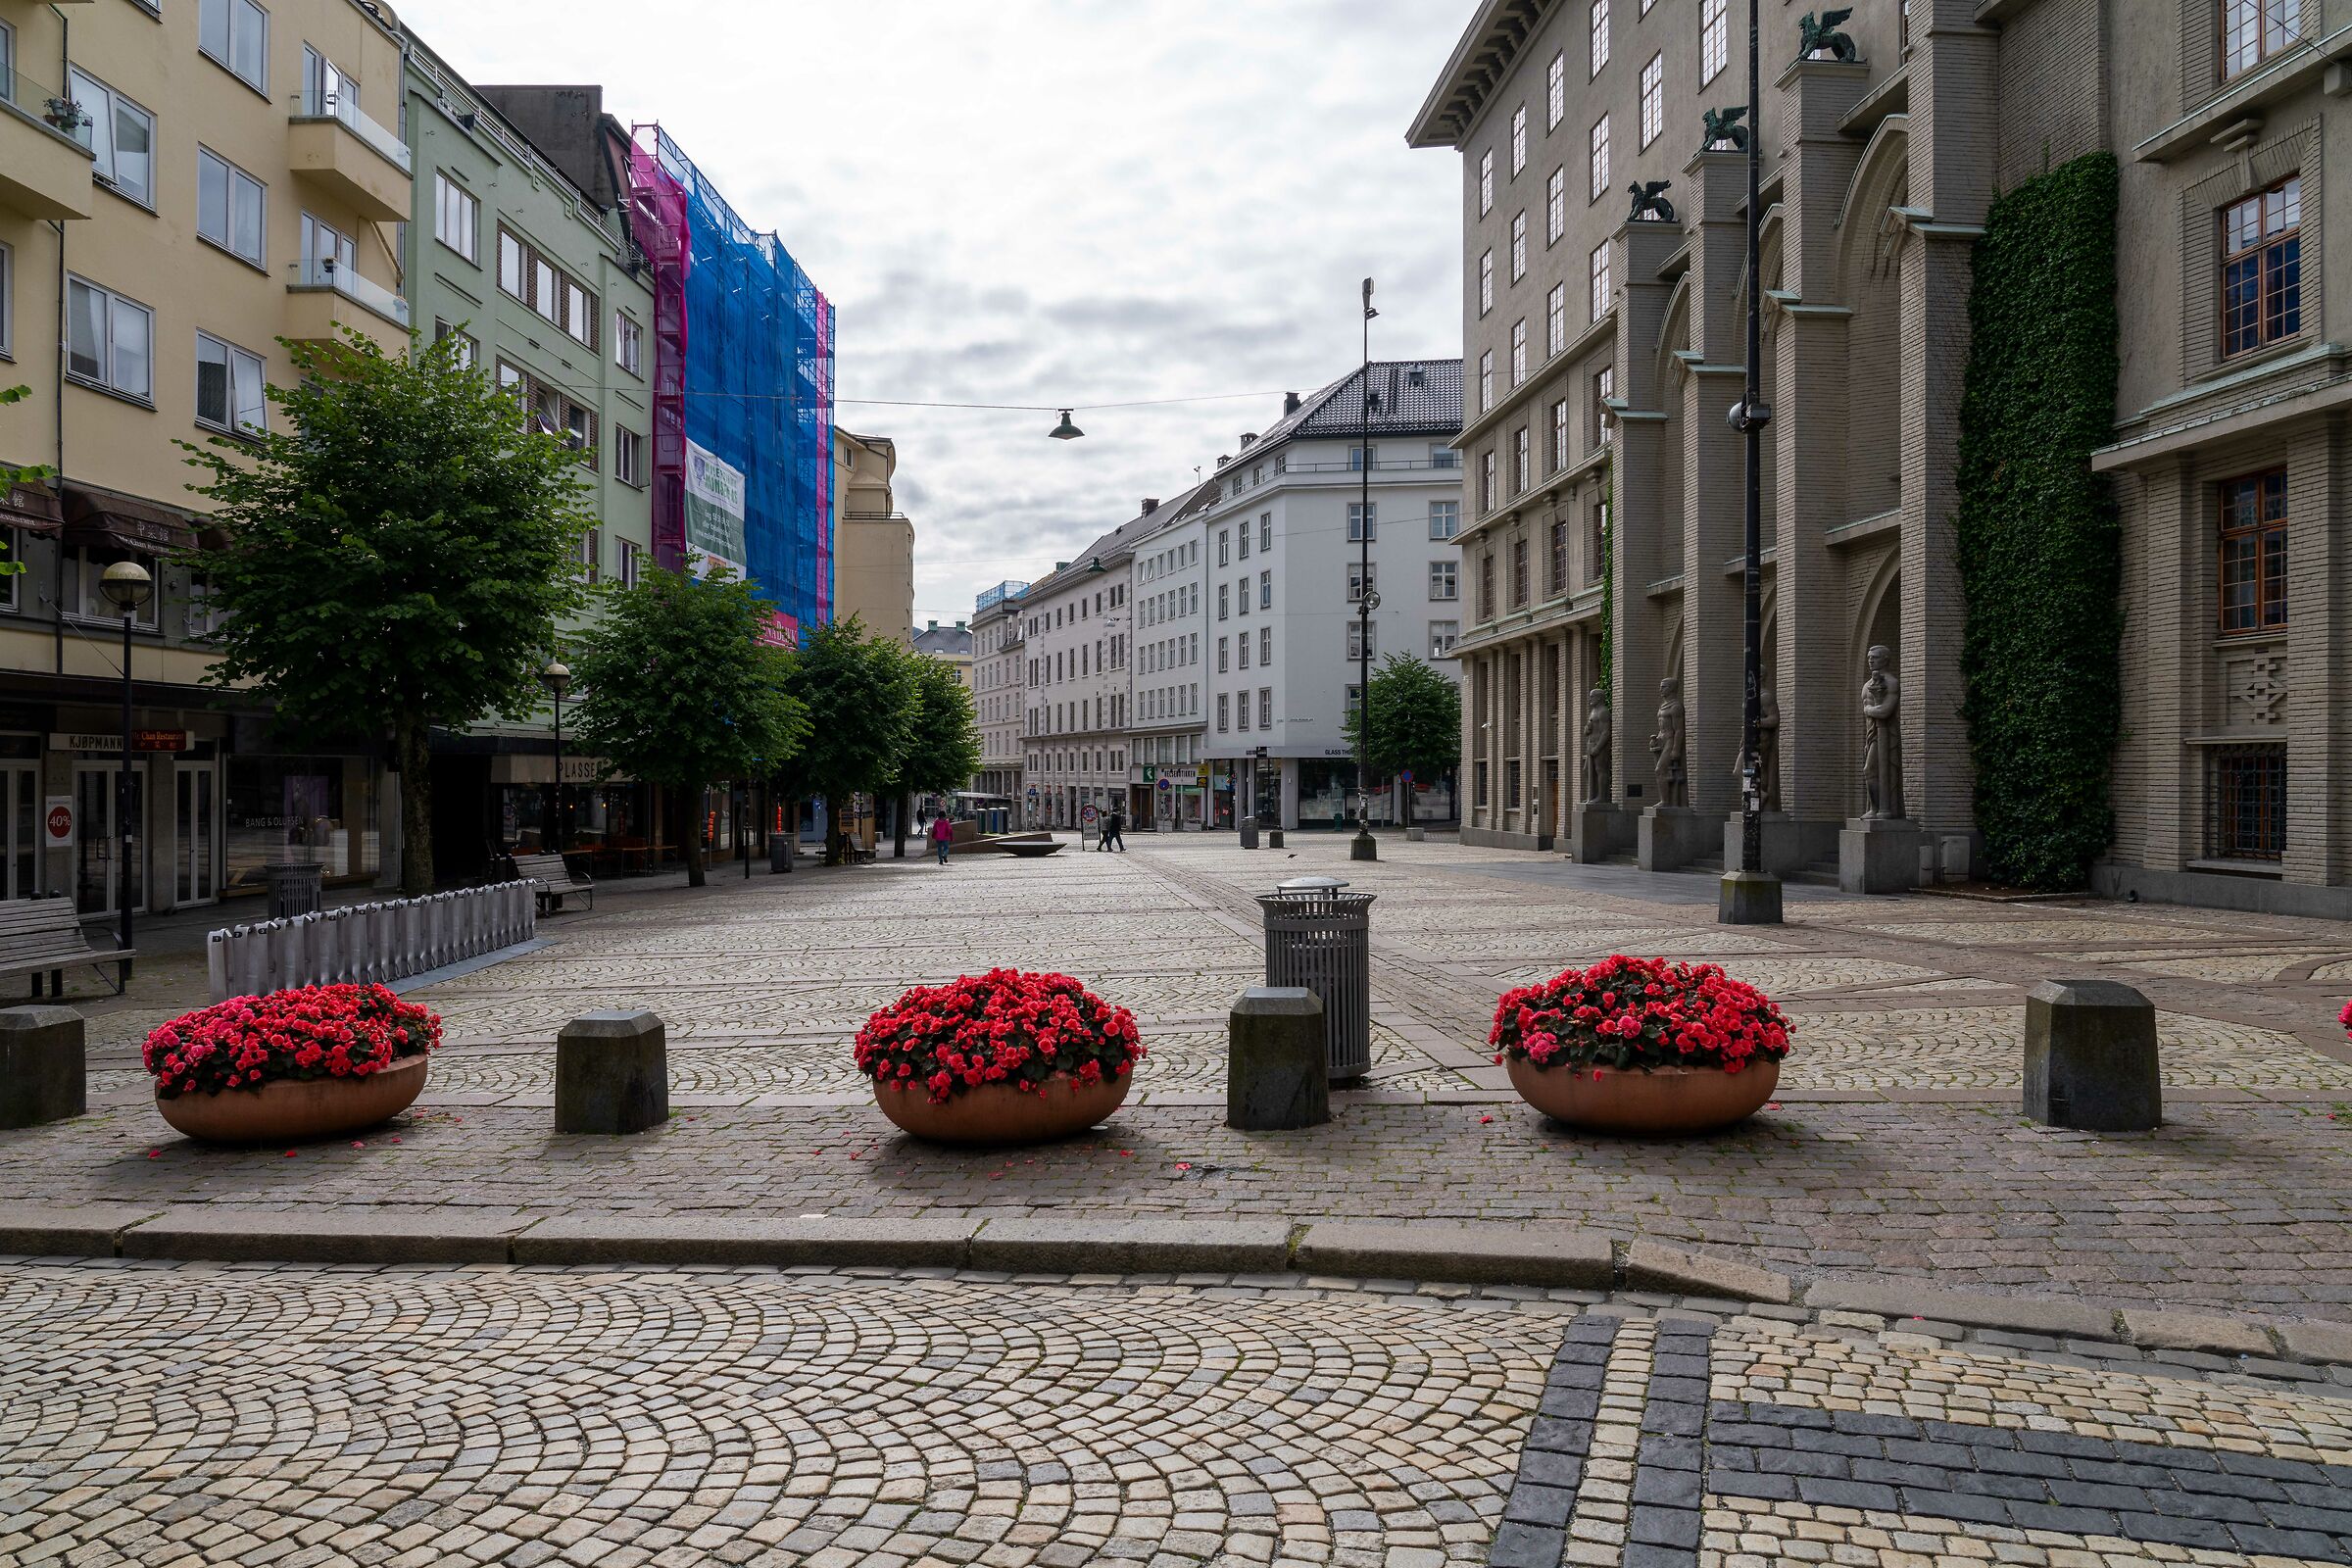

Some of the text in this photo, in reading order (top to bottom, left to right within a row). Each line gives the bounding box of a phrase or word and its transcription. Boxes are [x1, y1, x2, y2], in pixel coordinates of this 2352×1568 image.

[141, 731, 156, 740] Chan
[156, 731, 184, 740] Restaurant
[70, 736, 122, 750] KJØPMANN
[49, 815, 72, 827] 40%
[245, 815, 304, 827] BANG & OLUFSEN
